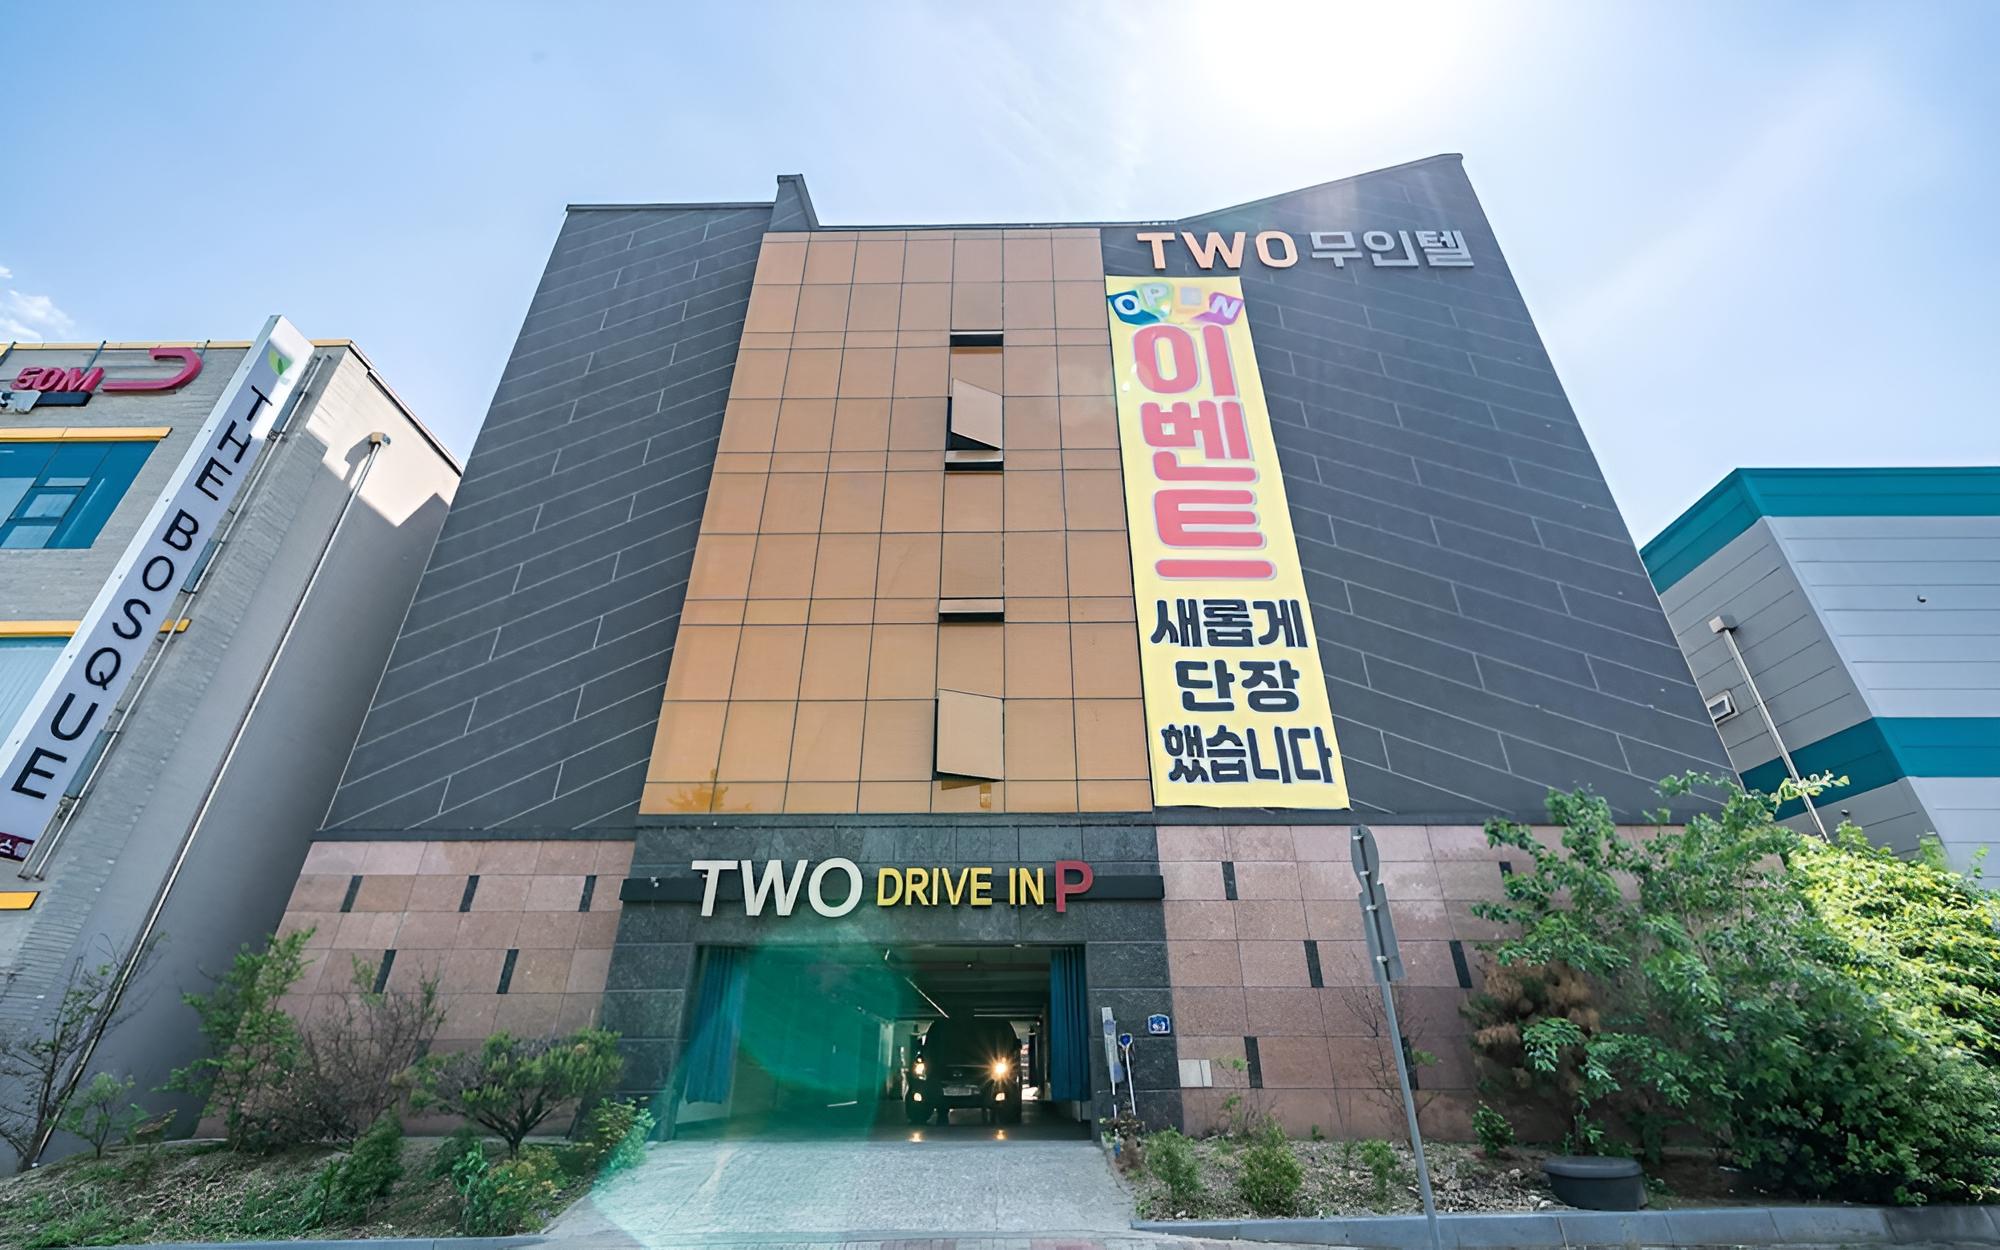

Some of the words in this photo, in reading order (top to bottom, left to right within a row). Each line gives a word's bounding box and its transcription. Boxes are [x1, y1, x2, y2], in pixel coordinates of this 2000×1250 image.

[1136, 230, 1299, 270] TWO
[1310, 230, 1475, 268] 무인텔
[1114, 282, 1241, 319] OPN
[10, 367, 104, 392] 50M
[195, 385, 272, 501] THE
[1132, 324, 1277, 581] 이벤트
[1150, 599, 1308, 647] 새롭게
[11, 509, 200, 800] BOSQUE
[1175, 659, 1300, 713] 단장
[1161, 724, 1334, 784] 했습니다
[691, 857, 864, 918] TWO
[877, 867, 993, 907] DRIVE
[1009, 867, 1045, 907] IN
[1055, 860, 1094, 913] P
